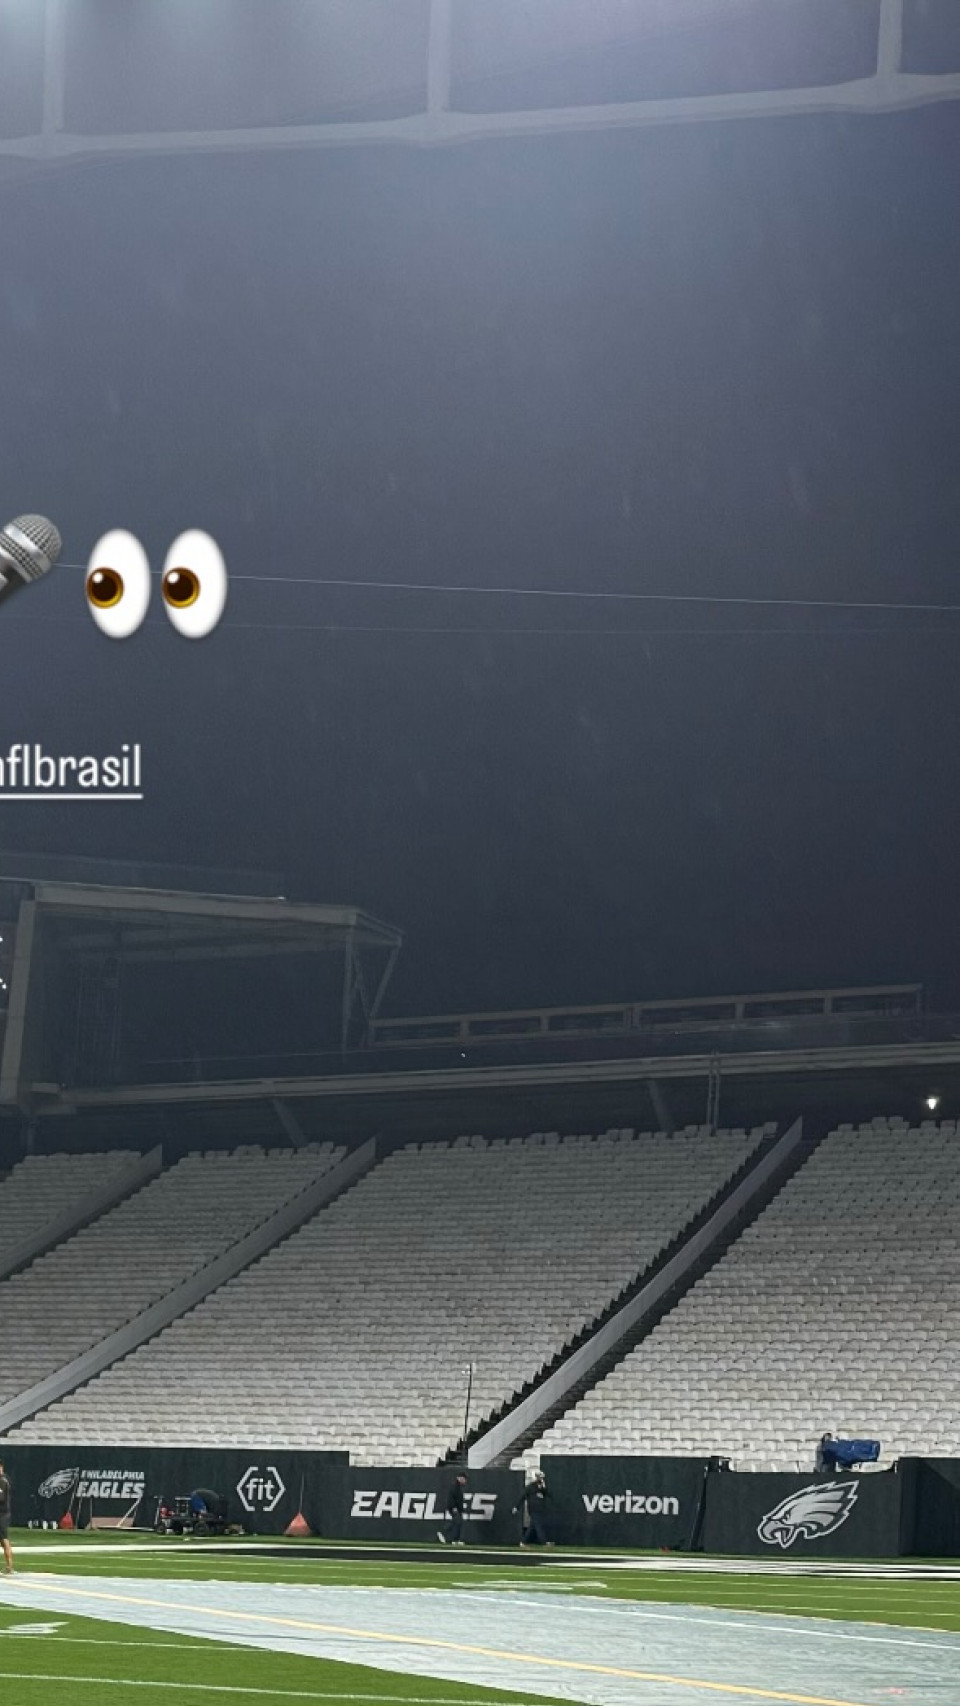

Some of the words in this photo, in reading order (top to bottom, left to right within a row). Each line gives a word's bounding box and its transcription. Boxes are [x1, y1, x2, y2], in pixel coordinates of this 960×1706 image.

[76, 1481, 145, 1499] EAGLES
[245, 1478, 275, 1500] fit
[582, 1490, 679, 1515] verizon
